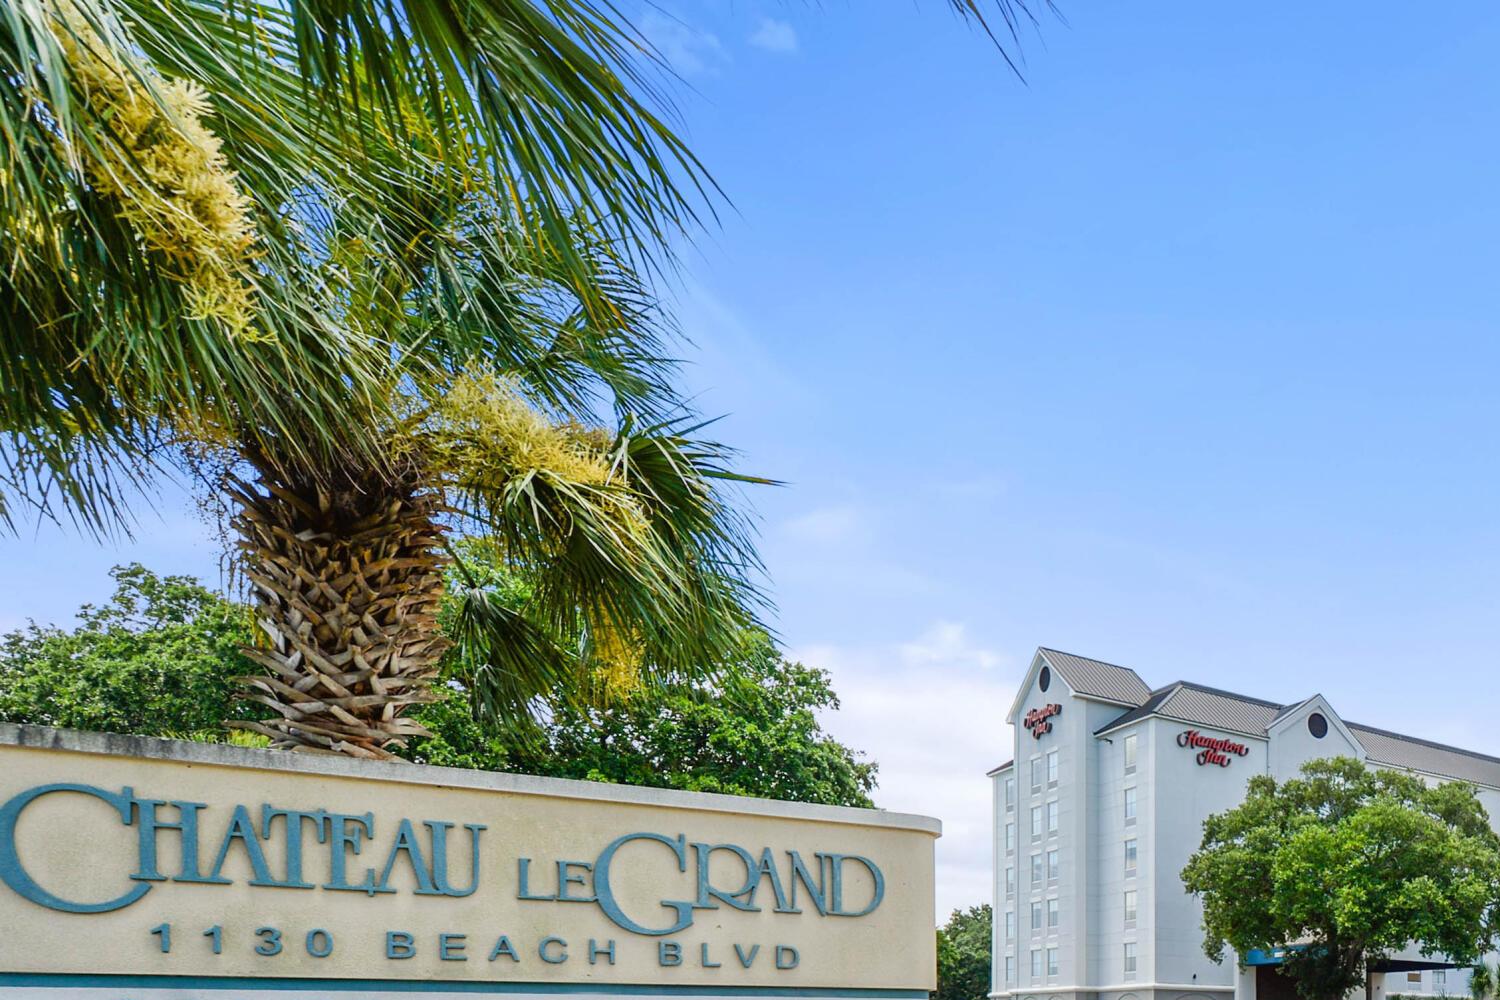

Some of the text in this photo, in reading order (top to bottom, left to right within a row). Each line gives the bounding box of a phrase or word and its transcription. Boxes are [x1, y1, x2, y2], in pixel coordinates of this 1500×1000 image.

[1177, 730, 1249, 757] Hampton
[1196, 749, 1231, 768] Inn
[0, 783, 488, 914] CHATEAU
[151, 923, 800, 970] 1130 BEACH BLVD
